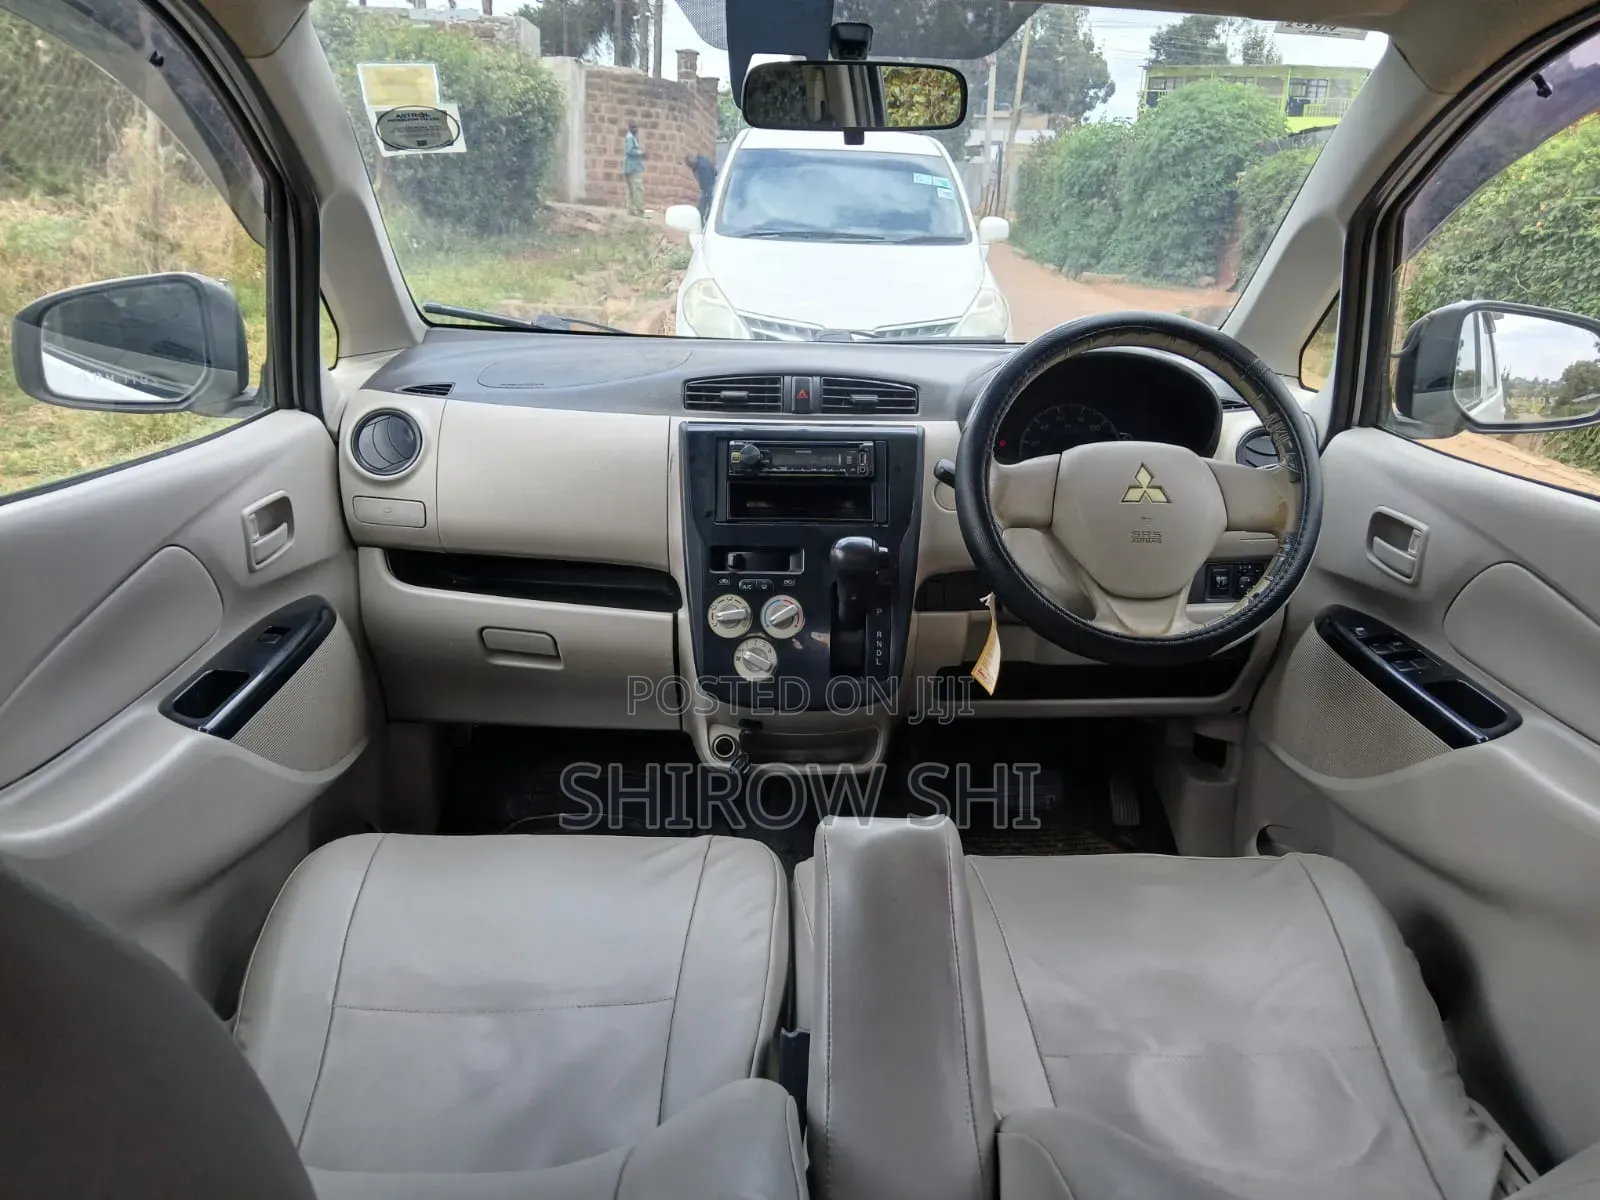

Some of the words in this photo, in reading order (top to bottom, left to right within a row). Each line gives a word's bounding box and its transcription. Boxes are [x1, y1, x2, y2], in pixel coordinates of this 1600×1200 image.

[876, 608, 883, 616] P
[876, 630, 882, 639] R
[876, 640, 882, 648] N
[876, 649, 882, 657] D
[876, 657, 882, 666] L
